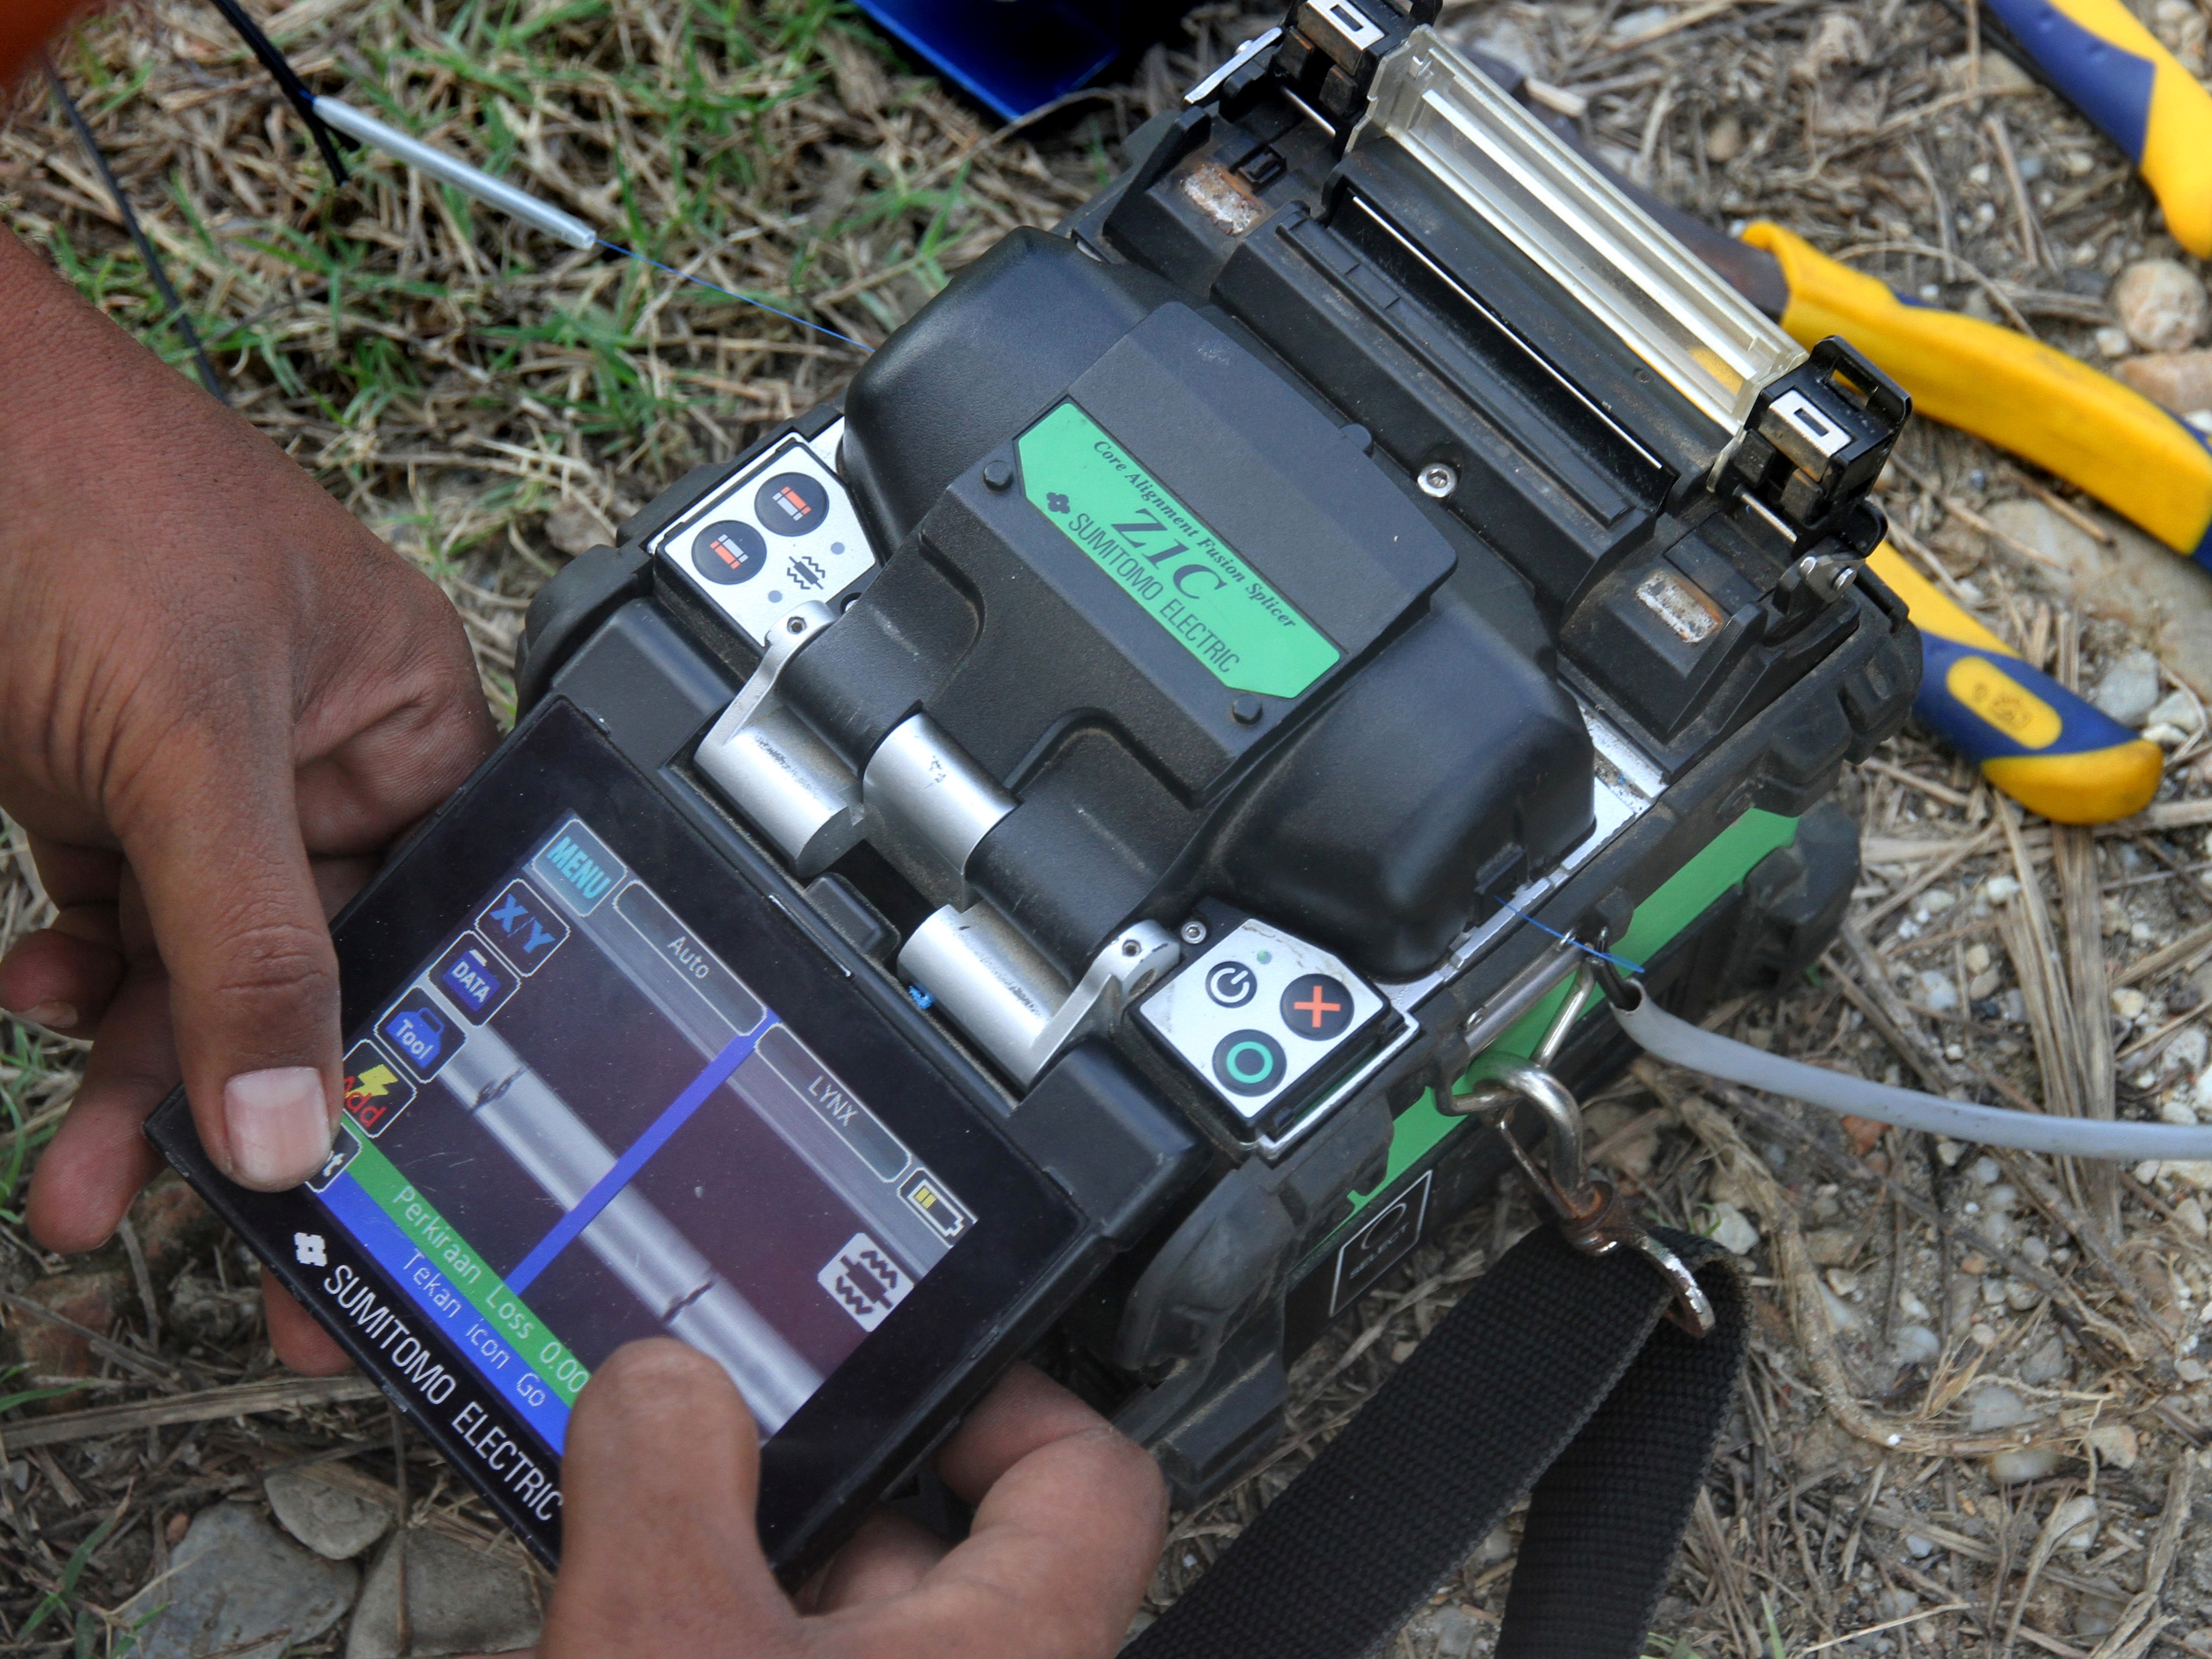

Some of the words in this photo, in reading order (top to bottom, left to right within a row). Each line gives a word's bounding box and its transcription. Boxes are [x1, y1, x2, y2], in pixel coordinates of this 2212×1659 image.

[1093, 440, 1127, 472] Core
[1125, 470, 1198, 538] Alignment
[1197, 536, 1247, 583] Fusion
[1245, 582, 1296, 628] Splicer
[1068, 513, 1164, 601] SUMITOMO
[1159, 598, 1240, 674] ELECTRIC
[545, 836, 611, 901] MENU
[451, 961, 491, 1004] DATA
[667, 935, 710, 980] Auto
[401, 1018, 435, 1060] Tool
[808, 1076, 859, 1127] LYNX
[1350, 1224, 1408, 1279] SELECT
[392, 1185, 483, 1285] Perkiraan
[485, 1284, 534, 1341] Loss
[539, 1341, 589, 1393] 0.00
[402, 1248, 462, 1319] Tekan
[465, 1317, 511, 1370] icon
[516, 1372, 546, 1407] Go
[323, 1264, 456, 1405] SUMITOMO
[451, 1401, 564, 1521] ELECTRIC
